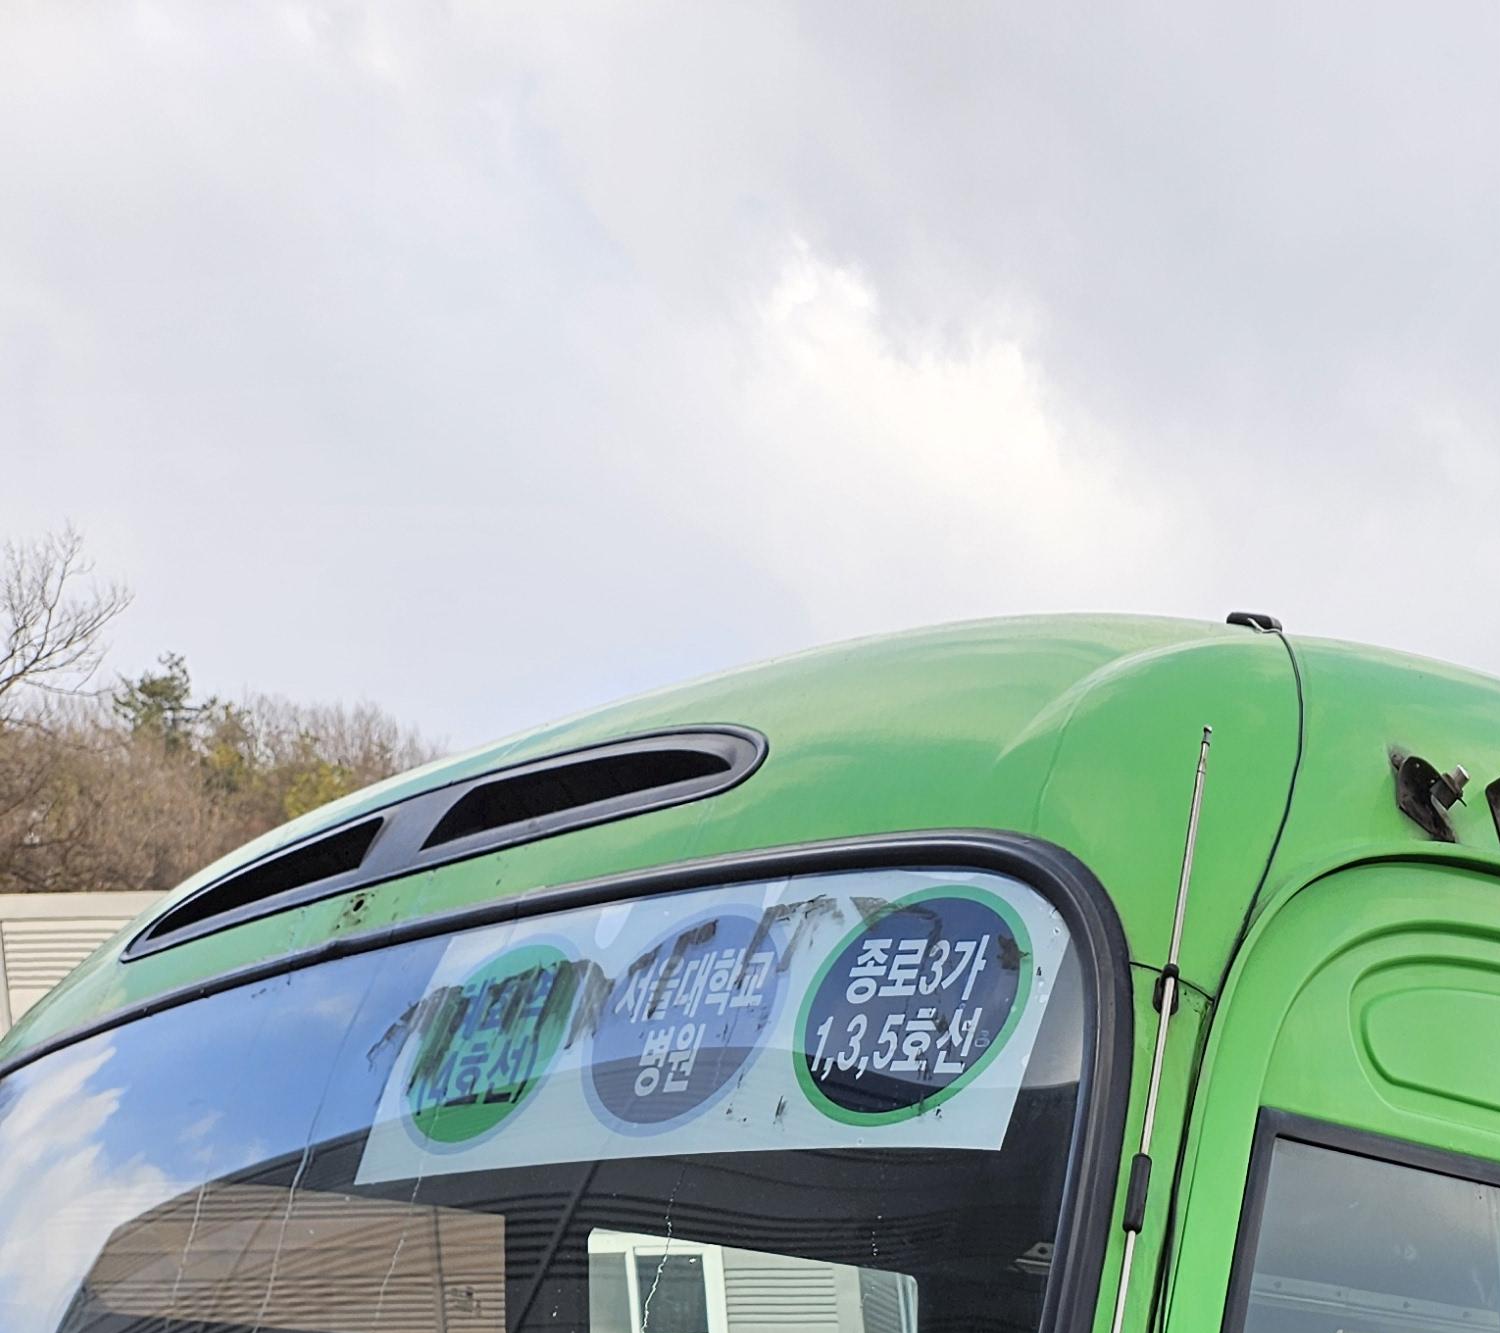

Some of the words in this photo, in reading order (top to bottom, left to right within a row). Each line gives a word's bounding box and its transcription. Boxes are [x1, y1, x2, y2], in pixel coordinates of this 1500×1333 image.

[614, 948, 775, 1024] 서울대학교
[846, 934, 990, 1004] 종로3가
[634, 1023, 706, 1097] 병원
[811, 1007, 983, 1080] 1,3,5호선
